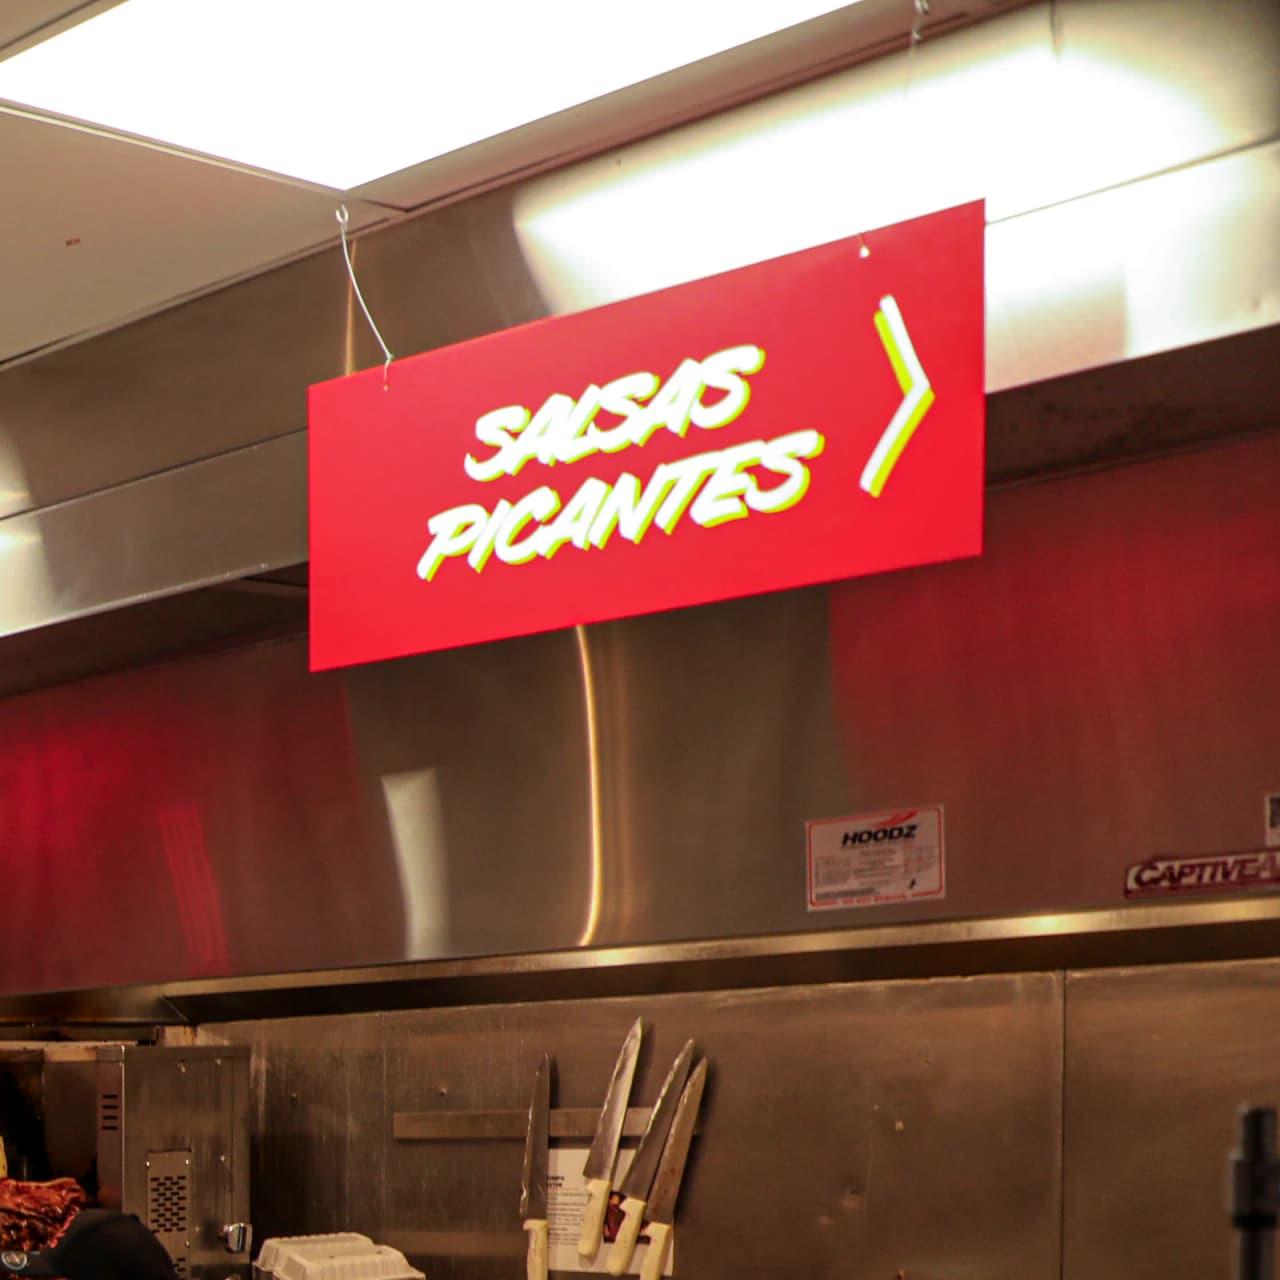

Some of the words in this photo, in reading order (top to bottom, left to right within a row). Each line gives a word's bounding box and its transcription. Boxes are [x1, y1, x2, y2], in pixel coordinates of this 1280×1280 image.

[463, 344, 765, 481] SALSAS
[416, 429, 825, 582] PICANTES
[842, 824, 918, 848] HOODZ
